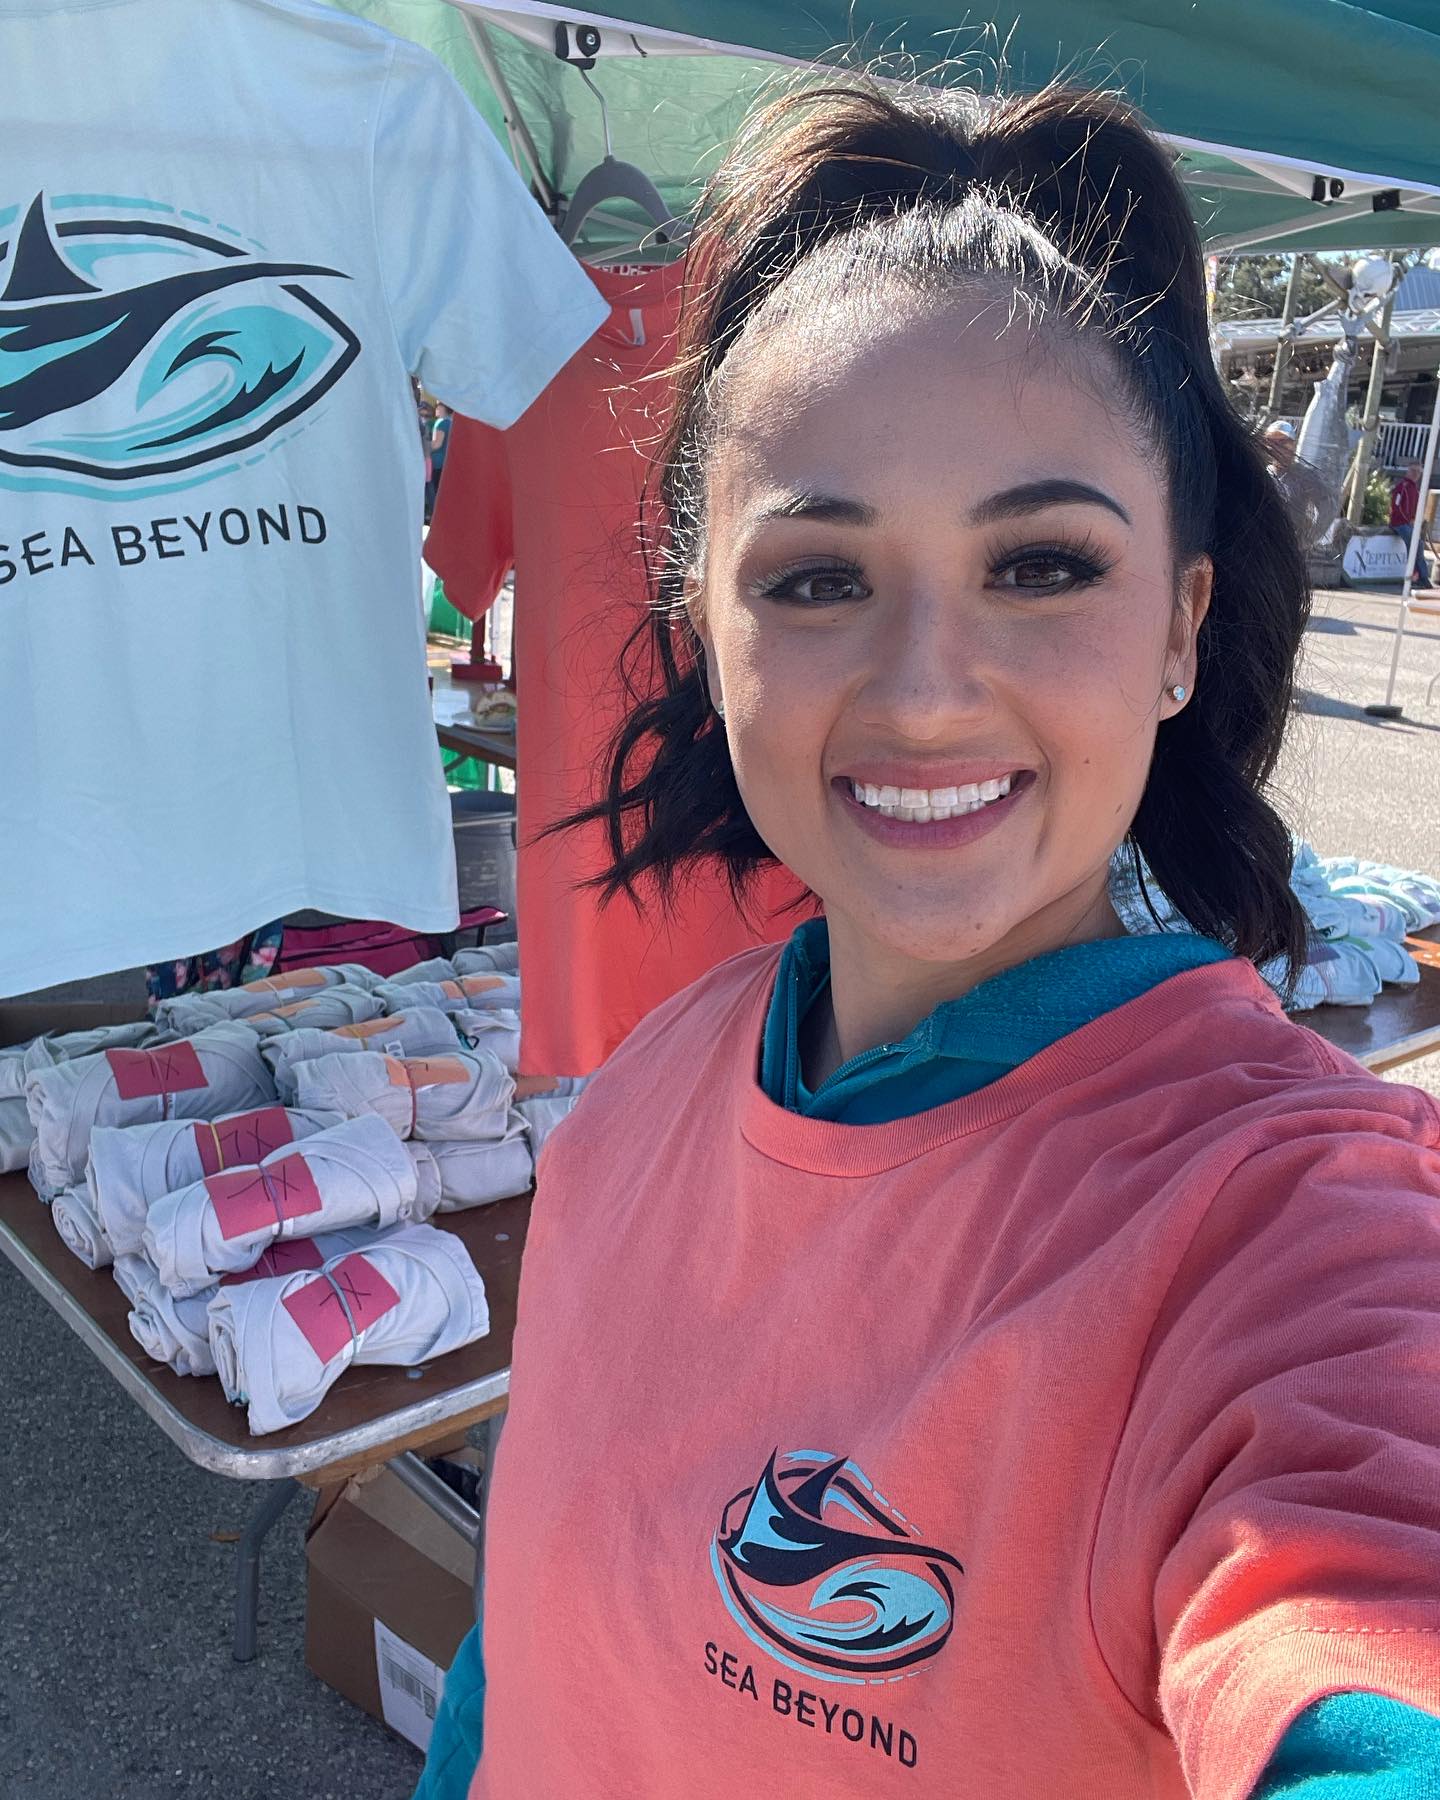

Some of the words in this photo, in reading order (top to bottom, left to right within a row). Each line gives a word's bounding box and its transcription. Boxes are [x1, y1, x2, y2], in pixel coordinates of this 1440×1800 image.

[111, 504, 327, 566] BEYOND
[219, 1118, 274, 1158] XL
[226, 1163, 302, 1202] XL
[704, 1641, 759, 1701] SEA
[772, 1678, 918, 1769] BEYOND
